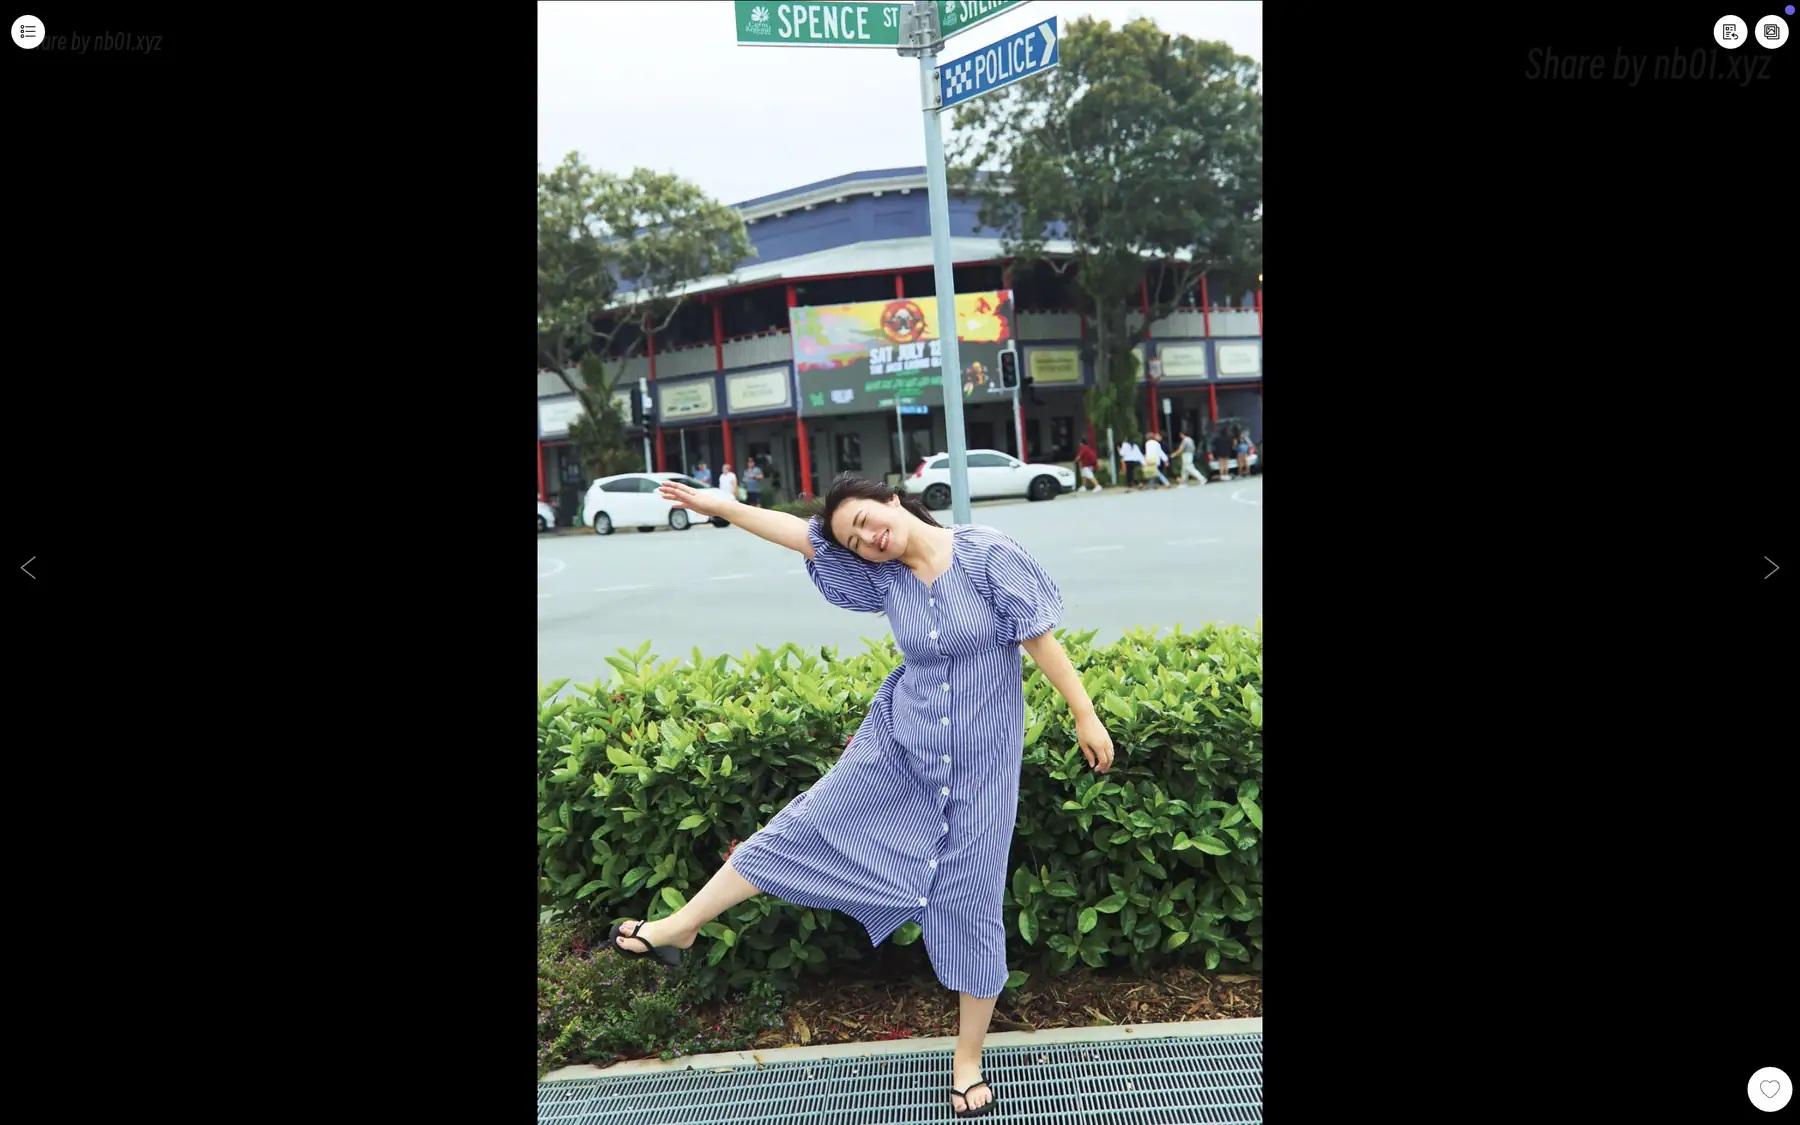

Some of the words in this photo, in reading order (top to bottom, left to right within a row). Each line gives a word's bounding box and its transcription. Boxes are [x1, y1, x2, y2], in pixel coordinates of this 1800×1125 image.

[777, 4, 871, 39] SPENCE
[883, 7, 899, 28] ST
[974, 32, 1038, 90] POLICE
[869, 346, 893, 365] SAT
